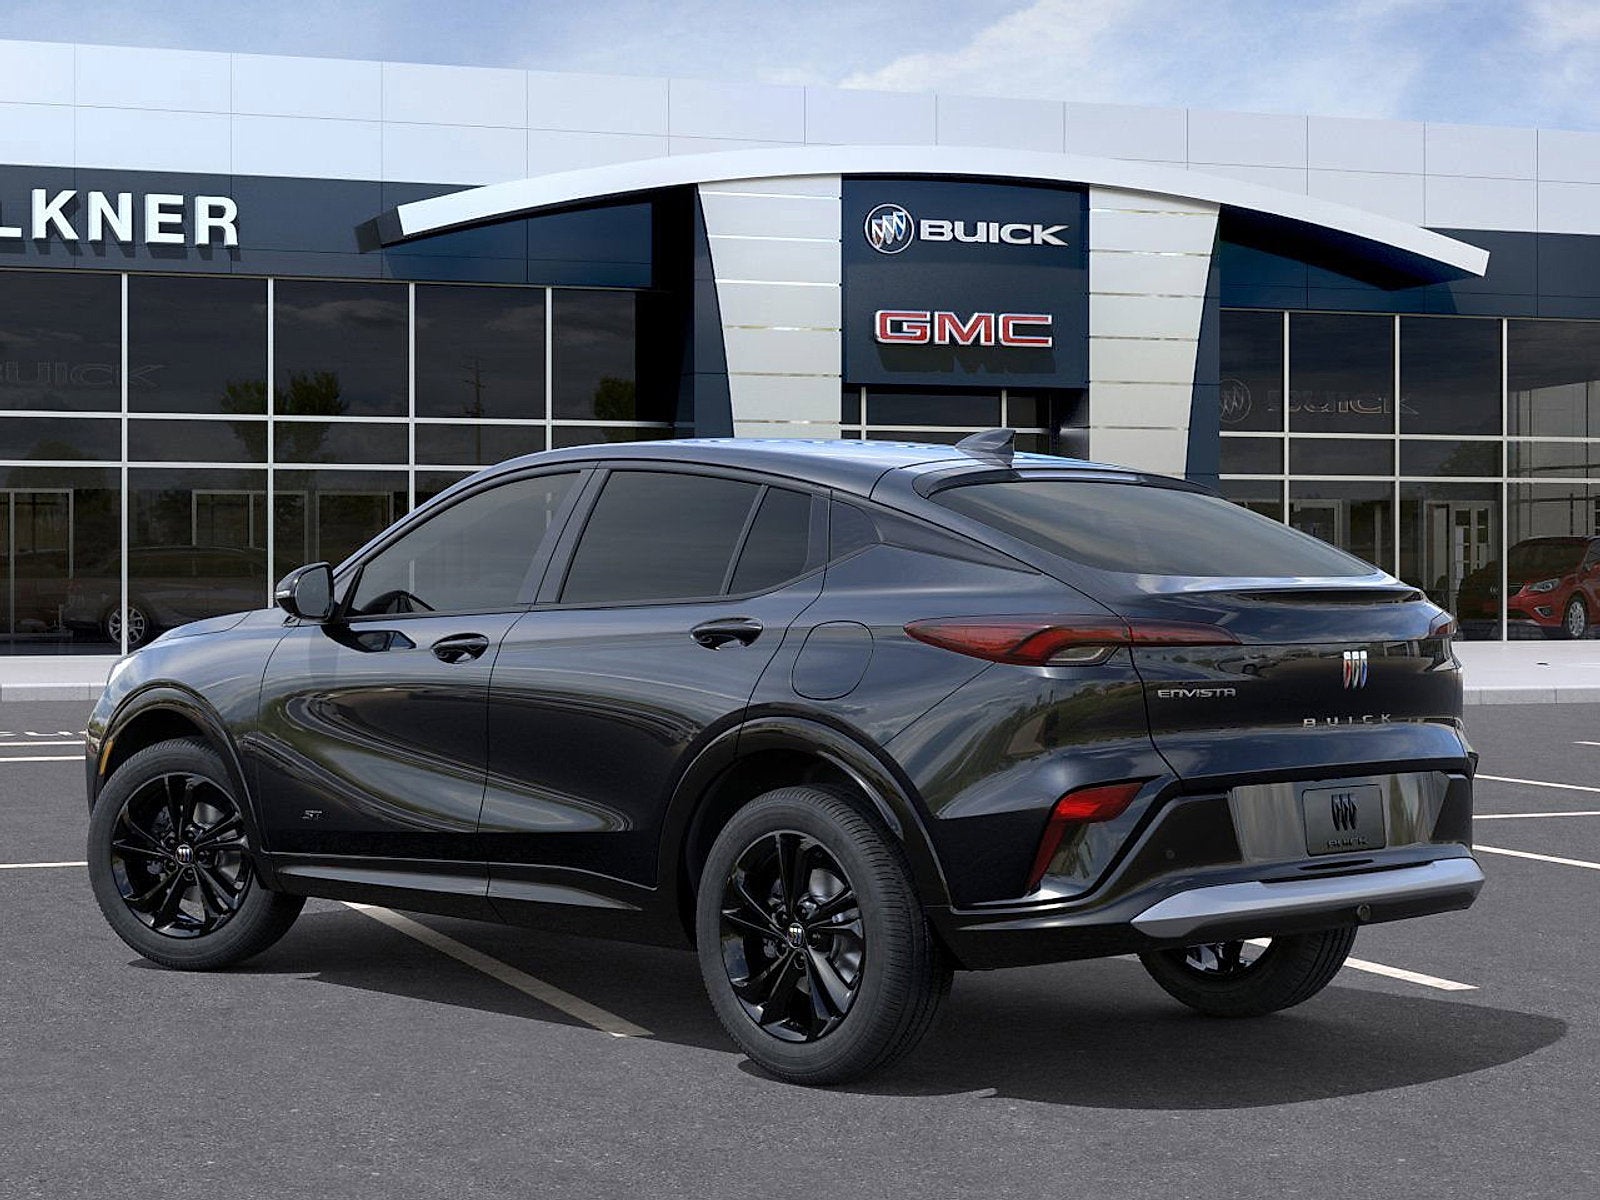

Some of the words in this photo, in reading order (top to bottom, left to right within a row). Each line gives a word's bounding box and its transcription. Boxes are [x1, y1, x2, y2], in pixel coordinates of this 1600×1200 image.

[919, 218, 1070, 247] BUICK
[874, 309, 1054, 348] GMC
[0, 360, 167, 388] UICK
[1157, 687, 1237, 699] ENVISTA
[1302, 713, 1393, 728] BUICK
